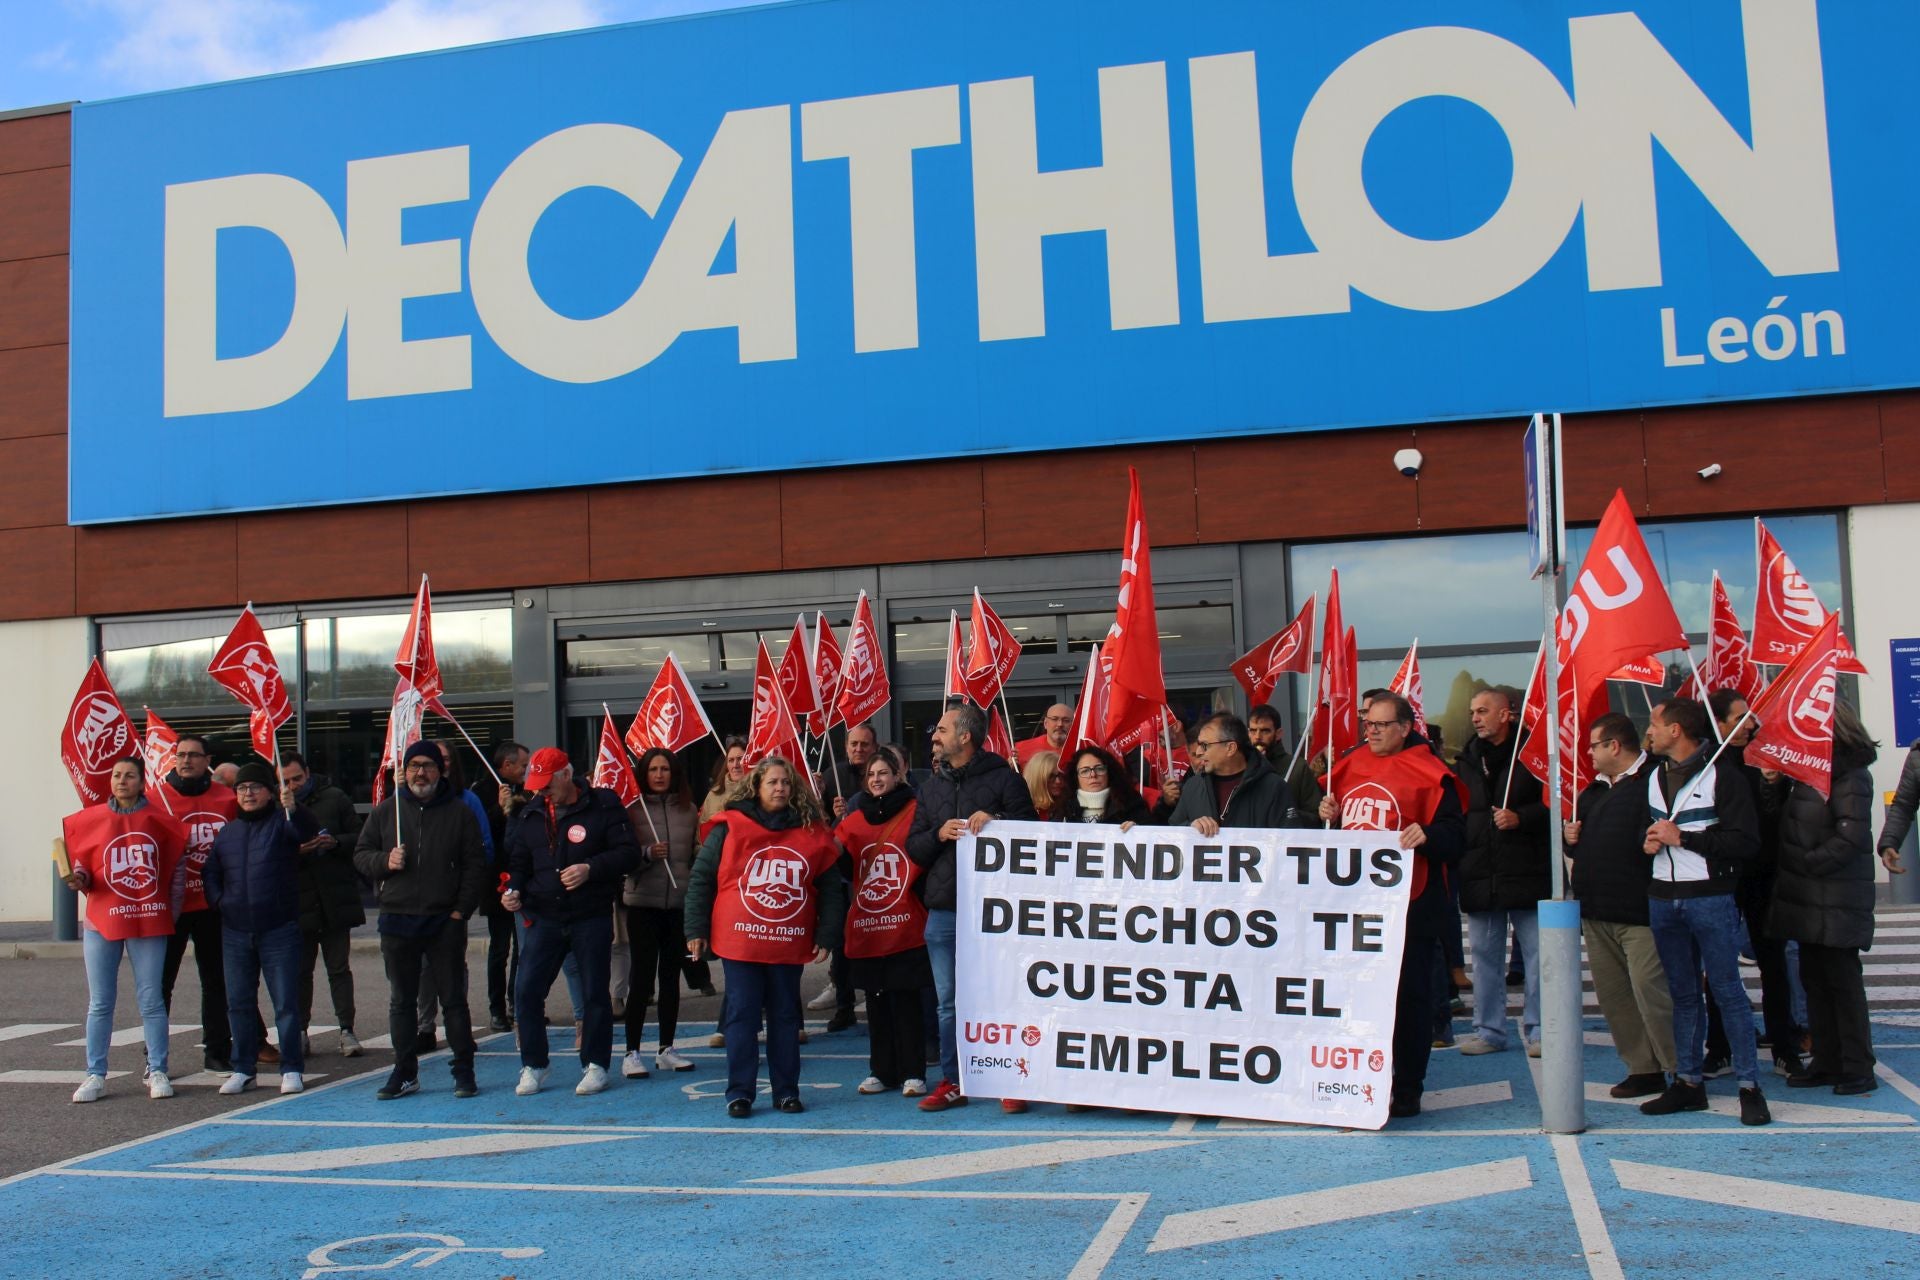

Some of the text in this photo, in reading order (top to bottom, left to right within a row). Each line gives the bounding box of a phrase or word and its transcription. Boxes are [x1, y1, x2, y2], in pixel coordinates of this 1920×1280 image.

[163, 0, 1839, 418] DECATHLON
[1660, 295, 1846, 368] León
[1341, 797, 1391, 831] UGT
[111, 844, 155, 872] UGT
[748, 858, 804, 889] UGT
[974, 837, 1404, 888] DEFENDER TUS
[734, 922, 767, 933] mano
[776, 926, 805, 936] mano
[880, 912, 911, 924] mano
[981, 897, 1385, 952] DERECHOS TE
[1026, 960, 1342, 1018] CUESTA EL
[965, 1021, 1017, 1046] UGT
[970, 1055, 1012, 1069] FeSMC
[1056, 1032, 1283, 1085] EMPLEO
[1311, 1045, 1364, 1071] UGT
[1317, 1081, 1359, 1096] FeSMC
